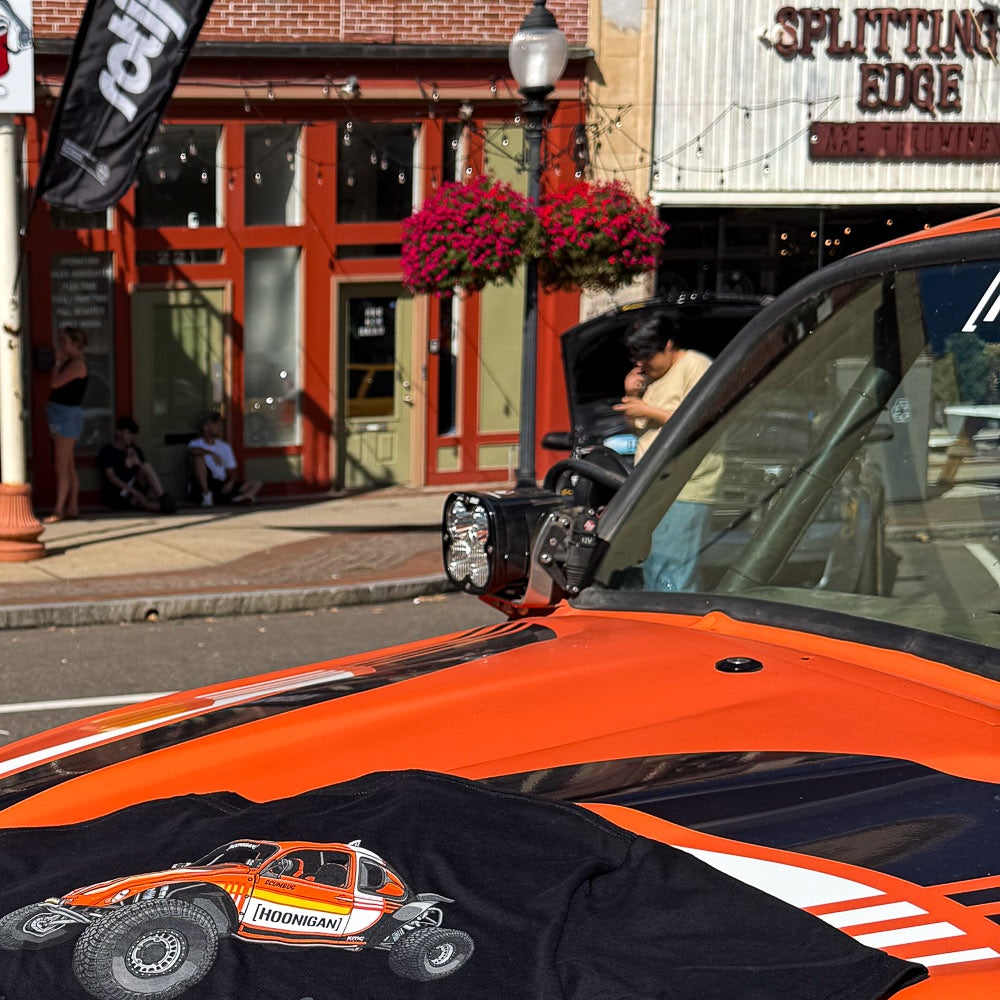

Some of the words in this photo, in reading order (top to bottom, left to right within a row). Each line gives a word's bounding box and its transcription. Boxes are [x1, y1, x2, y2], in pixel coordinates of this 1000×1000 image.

[775, 6, 998, 58] SPLITTING
[858, 63, 963, 118] EDGE
[825, 125, 867, 153] AXE
[880, 125, 993, 153] THROWING
[581, 537, 593, 545] 12V
[264, 879, 297, 891] SCUMBUG
[252, 903, 343, 931] [HOONIGAN]
